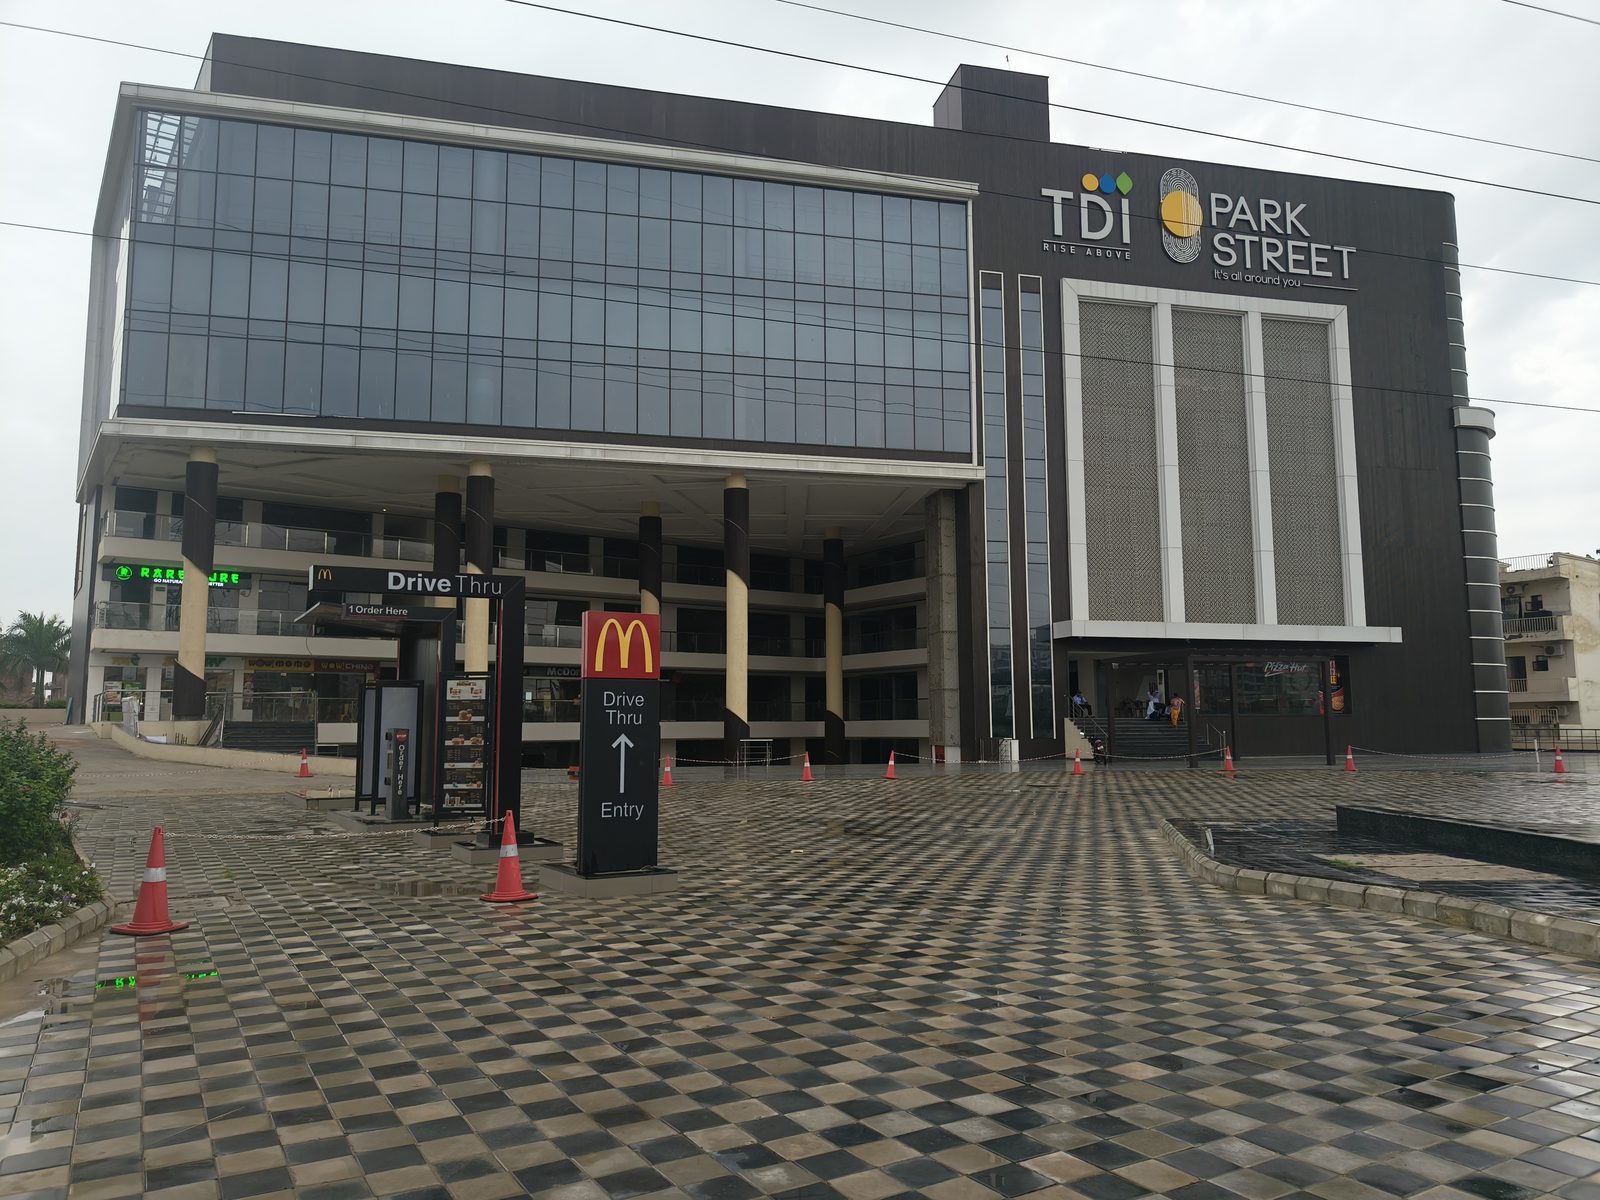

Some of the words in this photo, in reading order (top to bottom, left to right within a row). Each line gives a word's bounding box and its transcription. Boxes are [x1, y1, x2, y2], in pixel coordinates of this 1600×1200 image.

[1041, 187, 1131, 244] TDI
[1210, 192, 1311, 237] PARK
[1043, 243, 1076, 254] RISE
[1086, 248, 1131, 260] ABOVE
[1213, 232, 1357, 279] STREET
[1214, 269, 1229, 280] It's
[1231, 272, 1242, 281] all
[1244, 274, 1280, 285] around
[1282, 279, 1301, 288] you
[387, 572, 451, 593] Drive
[455, 575, 502, 595] Thru
[349, 605, 353, 614] 1
[355, 605, 383, 615] Order
[385, 607, 408, 616] Here
[1264, 661, 1289, 673] Pizza
[1289, 663, 1309, 672] Hut
[603, 691, 645, 706] Drive
[605, 710, 642, 725] Thru
[601, 802, 644, 821] Entry
